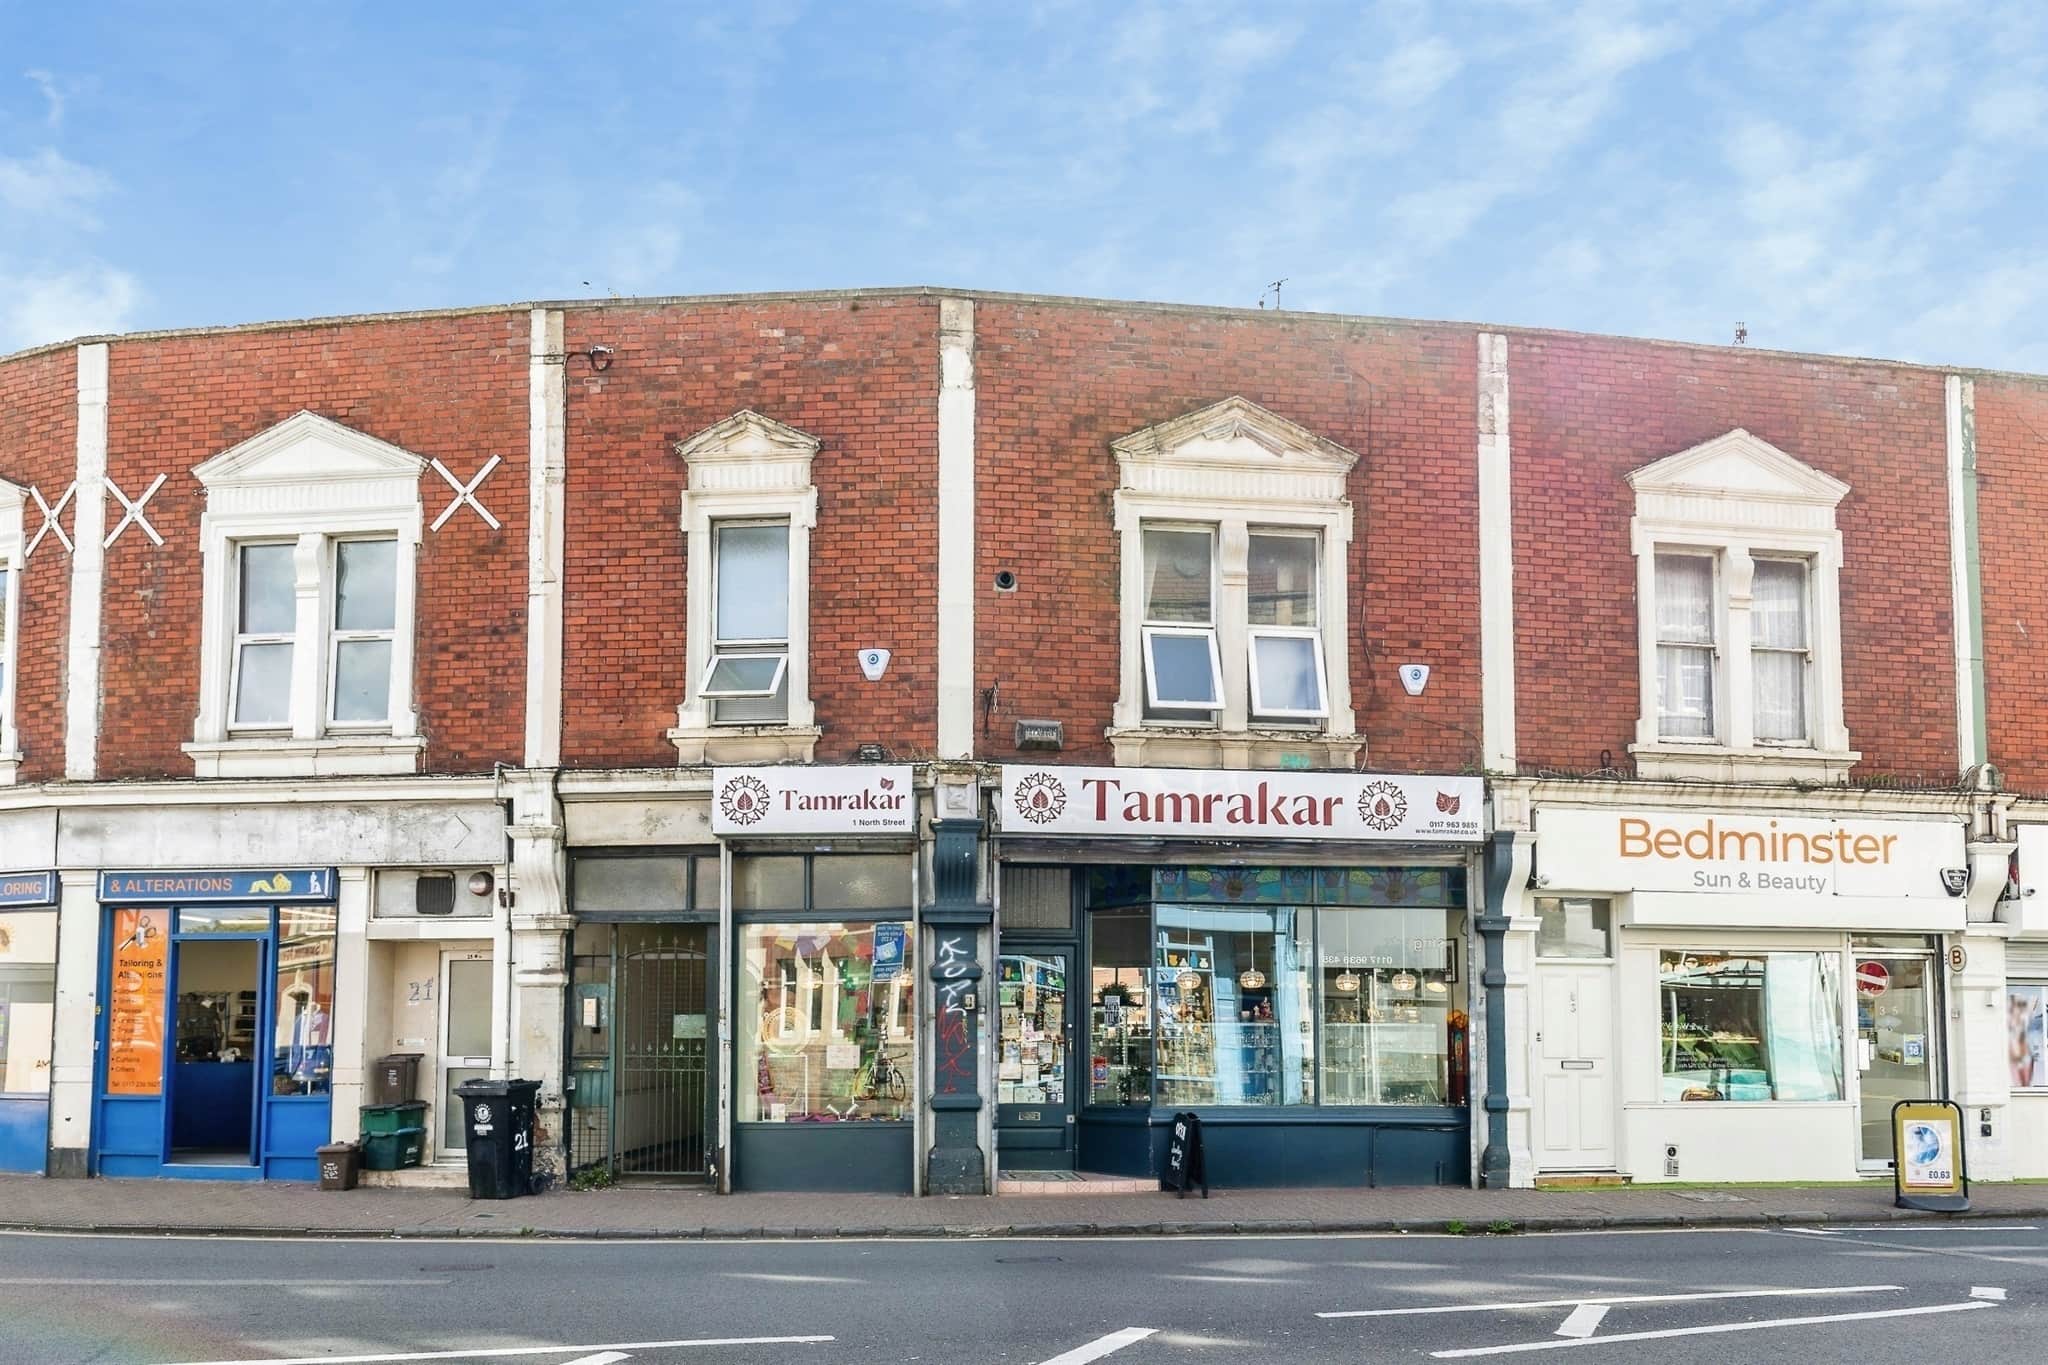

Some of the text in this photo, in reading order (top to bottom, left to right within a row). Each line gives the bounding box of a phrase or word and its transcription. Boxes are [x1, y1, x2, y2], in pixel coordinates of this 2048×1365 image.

[779, 788, 906, 811] Tamrakar
[1082, 779, 1344, 826] Tamrakar
[882, 818, 906, 826] Street
[1619, 817, 1898, 864] Bedminster
[110, 878, 233, 892] & ALTERATIONS
[1693, 870, 1827, 895] Sun & Beauty
[119, 959, 155, 969] Tailoring
[1952, 950, 1962, 965] B
[514, 1130, 529, 1152] 21
[1928, 1170, 1951, 1180] £0.63
